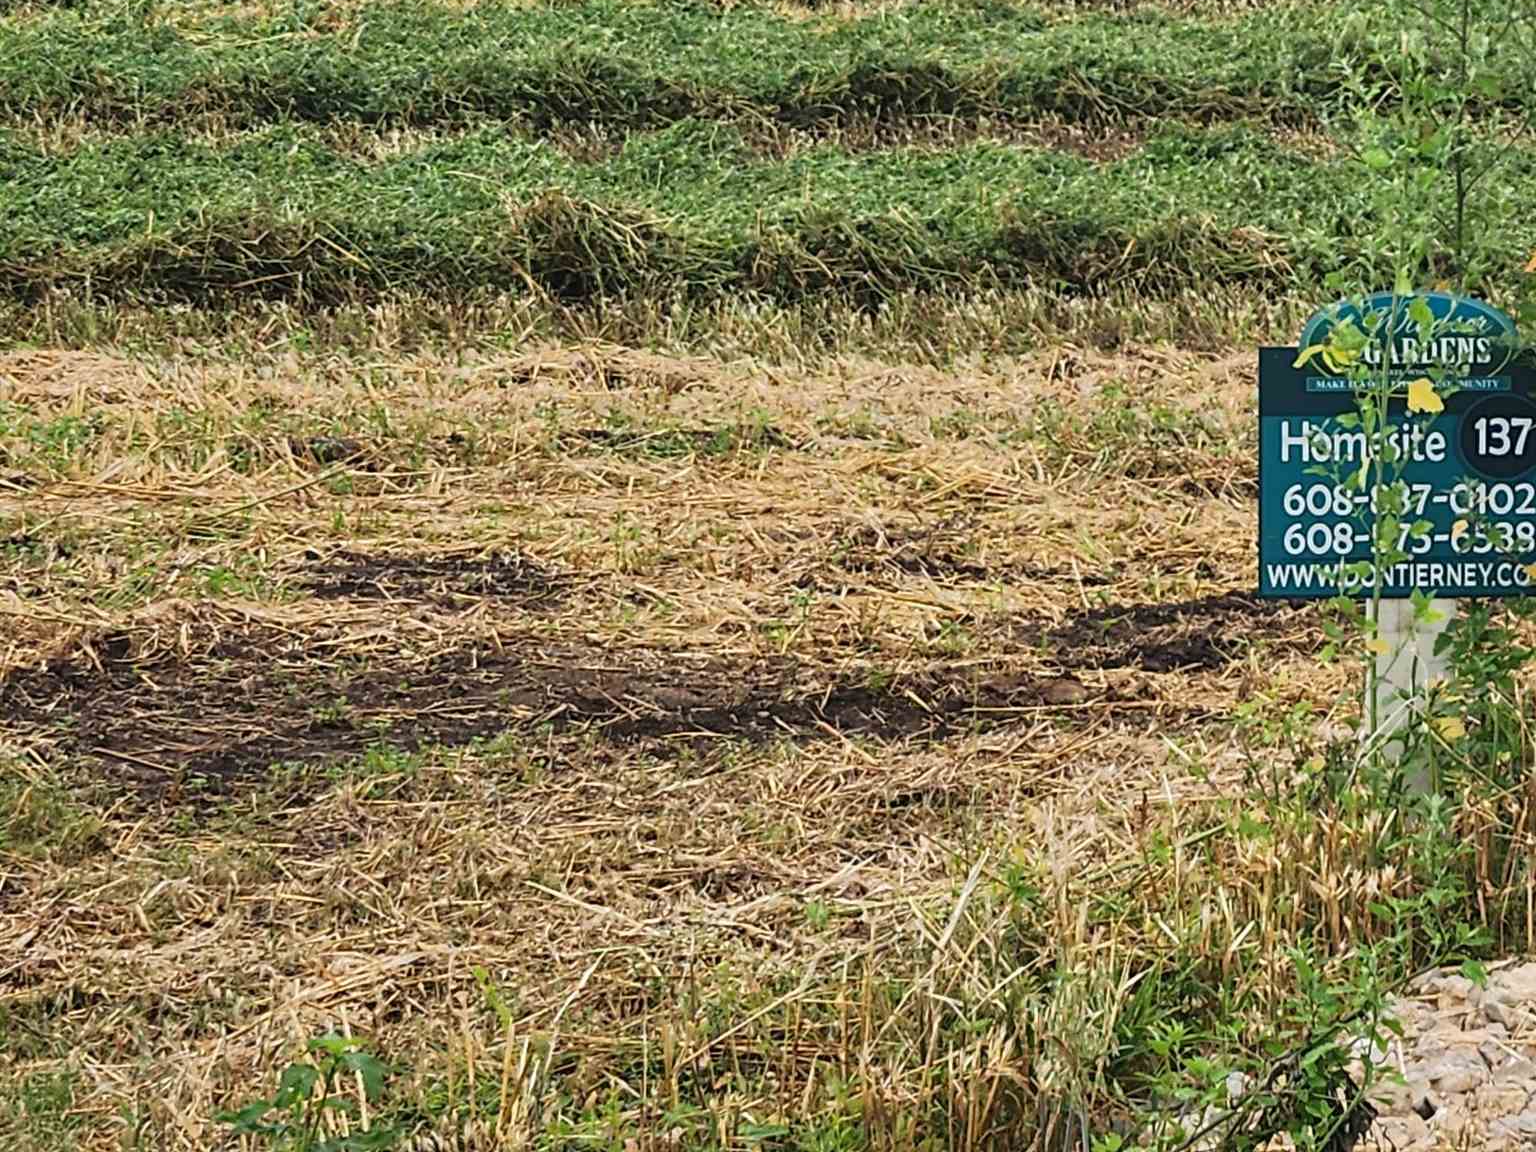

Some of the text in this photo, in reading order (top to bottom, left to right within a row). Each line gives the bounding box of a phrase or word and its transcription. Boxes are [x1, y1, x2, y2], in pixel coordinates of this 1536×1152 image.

[1364, 337, 1492, 365] GARDENS
[1315, 379, 1345, 389] MAKE
[1281, 418, 1533, 462] Homesite 137
